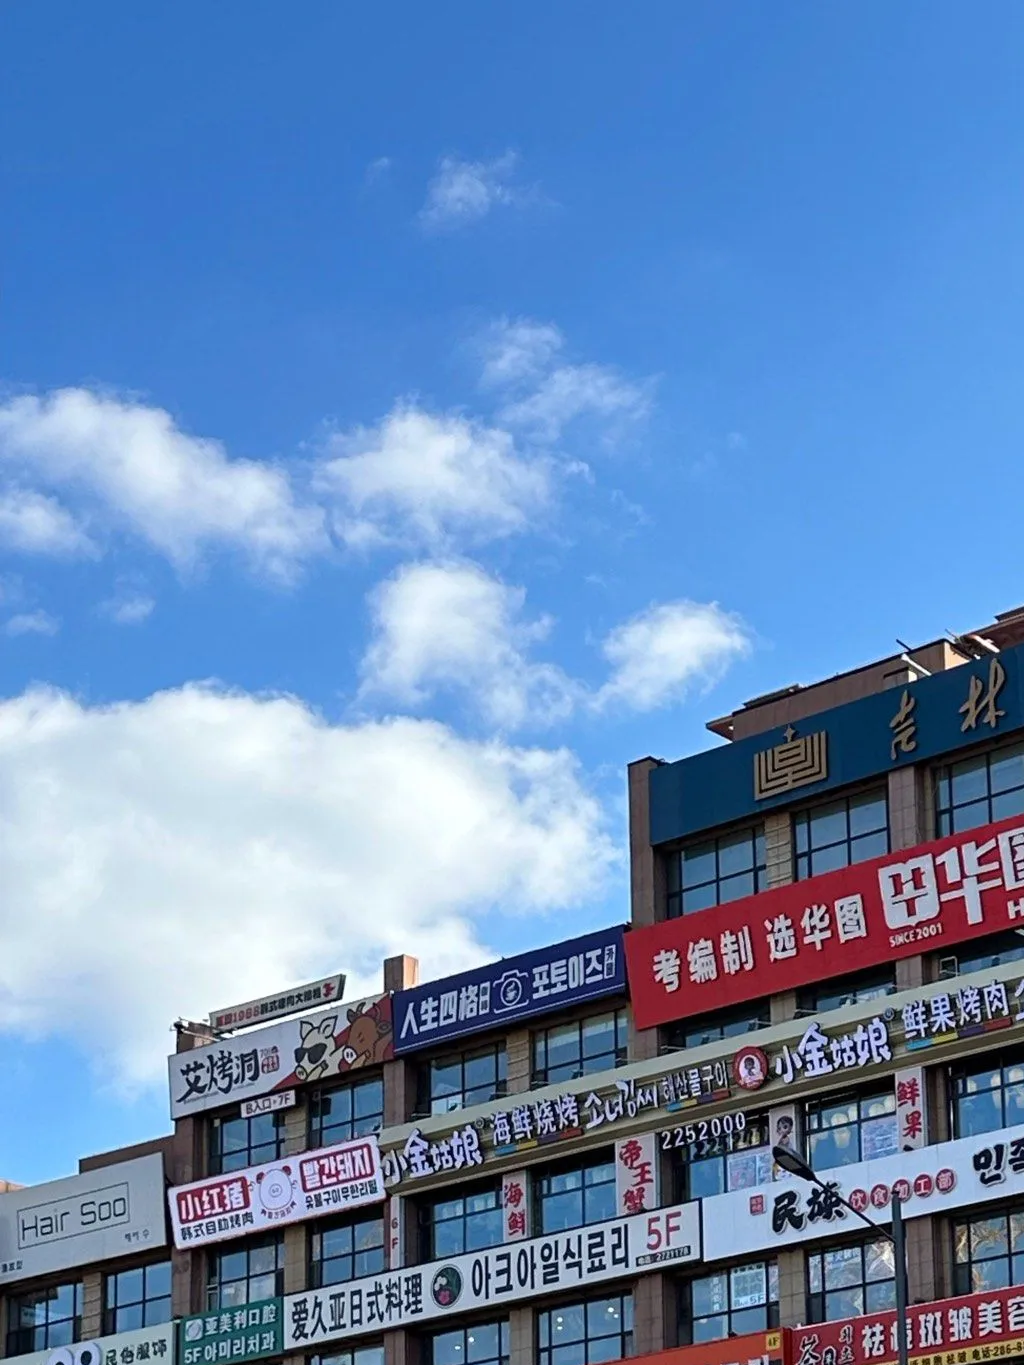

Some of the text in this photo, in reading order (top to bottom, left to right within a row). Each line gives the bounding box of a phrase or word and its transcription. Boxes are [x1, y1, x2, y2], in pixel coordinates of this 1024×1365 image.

[652, 893, 867, 993] 考编制 选华图
[532, 948, 604, 1000] 포토이즈
[400, 984, 479, 1039] 人生四格
[775, 981, 1010, 1084] 小金姑娘 鲜果烤肉
[661, 1061, 729, 1107] 해산물구이
[896, 1078, 924, 1138] 鲜果
[384, 1093, 580, 1186] 小金姑娘 海鲜烧烤
[662, 1111, 746, 1150] 2252000
[302, 1147, 372, 1190] 빨간돼지
[22, 1197, 127, 1242] Hair Soo
[180, 1211, 254, 1241] 韩式自助烤肉
[181, 1181, 244, 1220] 小红猪
[502, 1182, 526, 1237] 海鲜
[771, 1180, 848, 1233] 民族
[471, 1211, 682, 1300] 아크아일식료리 5F
[202, 1303, 277, 1339] 亚美利口腔
[290, 1271, 424, 1341] 爱久亚日式料理
[184, 1335, 276, 1365] 5F 아미리치과
